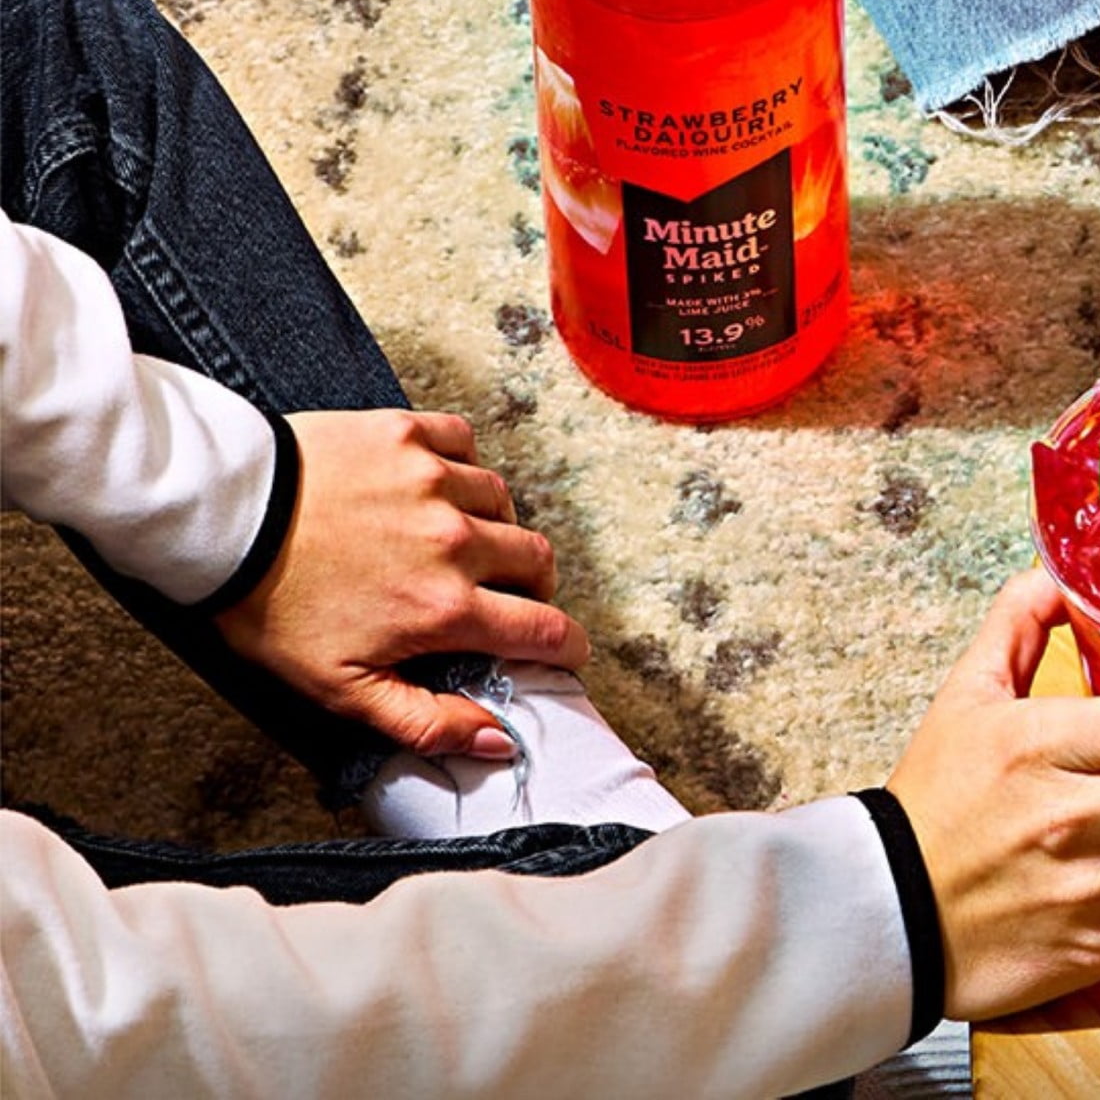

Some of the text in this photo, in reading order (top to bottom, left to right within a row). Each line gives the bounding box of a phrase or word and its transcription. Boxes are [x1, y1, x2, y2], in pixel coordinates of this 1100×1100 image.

[599, 76, 803, 130] STRAWBERRY
[615, 121, 793, 158] FLAVORED WINE COCKTAIL
[634, 112, 775, 146] DAIQUIRI
[643, 208, 777, 245] Minute
[662, 236, 761, 270] Maid
[665, 264, 760, 285] SPIKED
[666, 297, 703, 307] MADE
[706, 294, 740, 307] WITH
[679, 300, 751, 316] LIME JUICE
